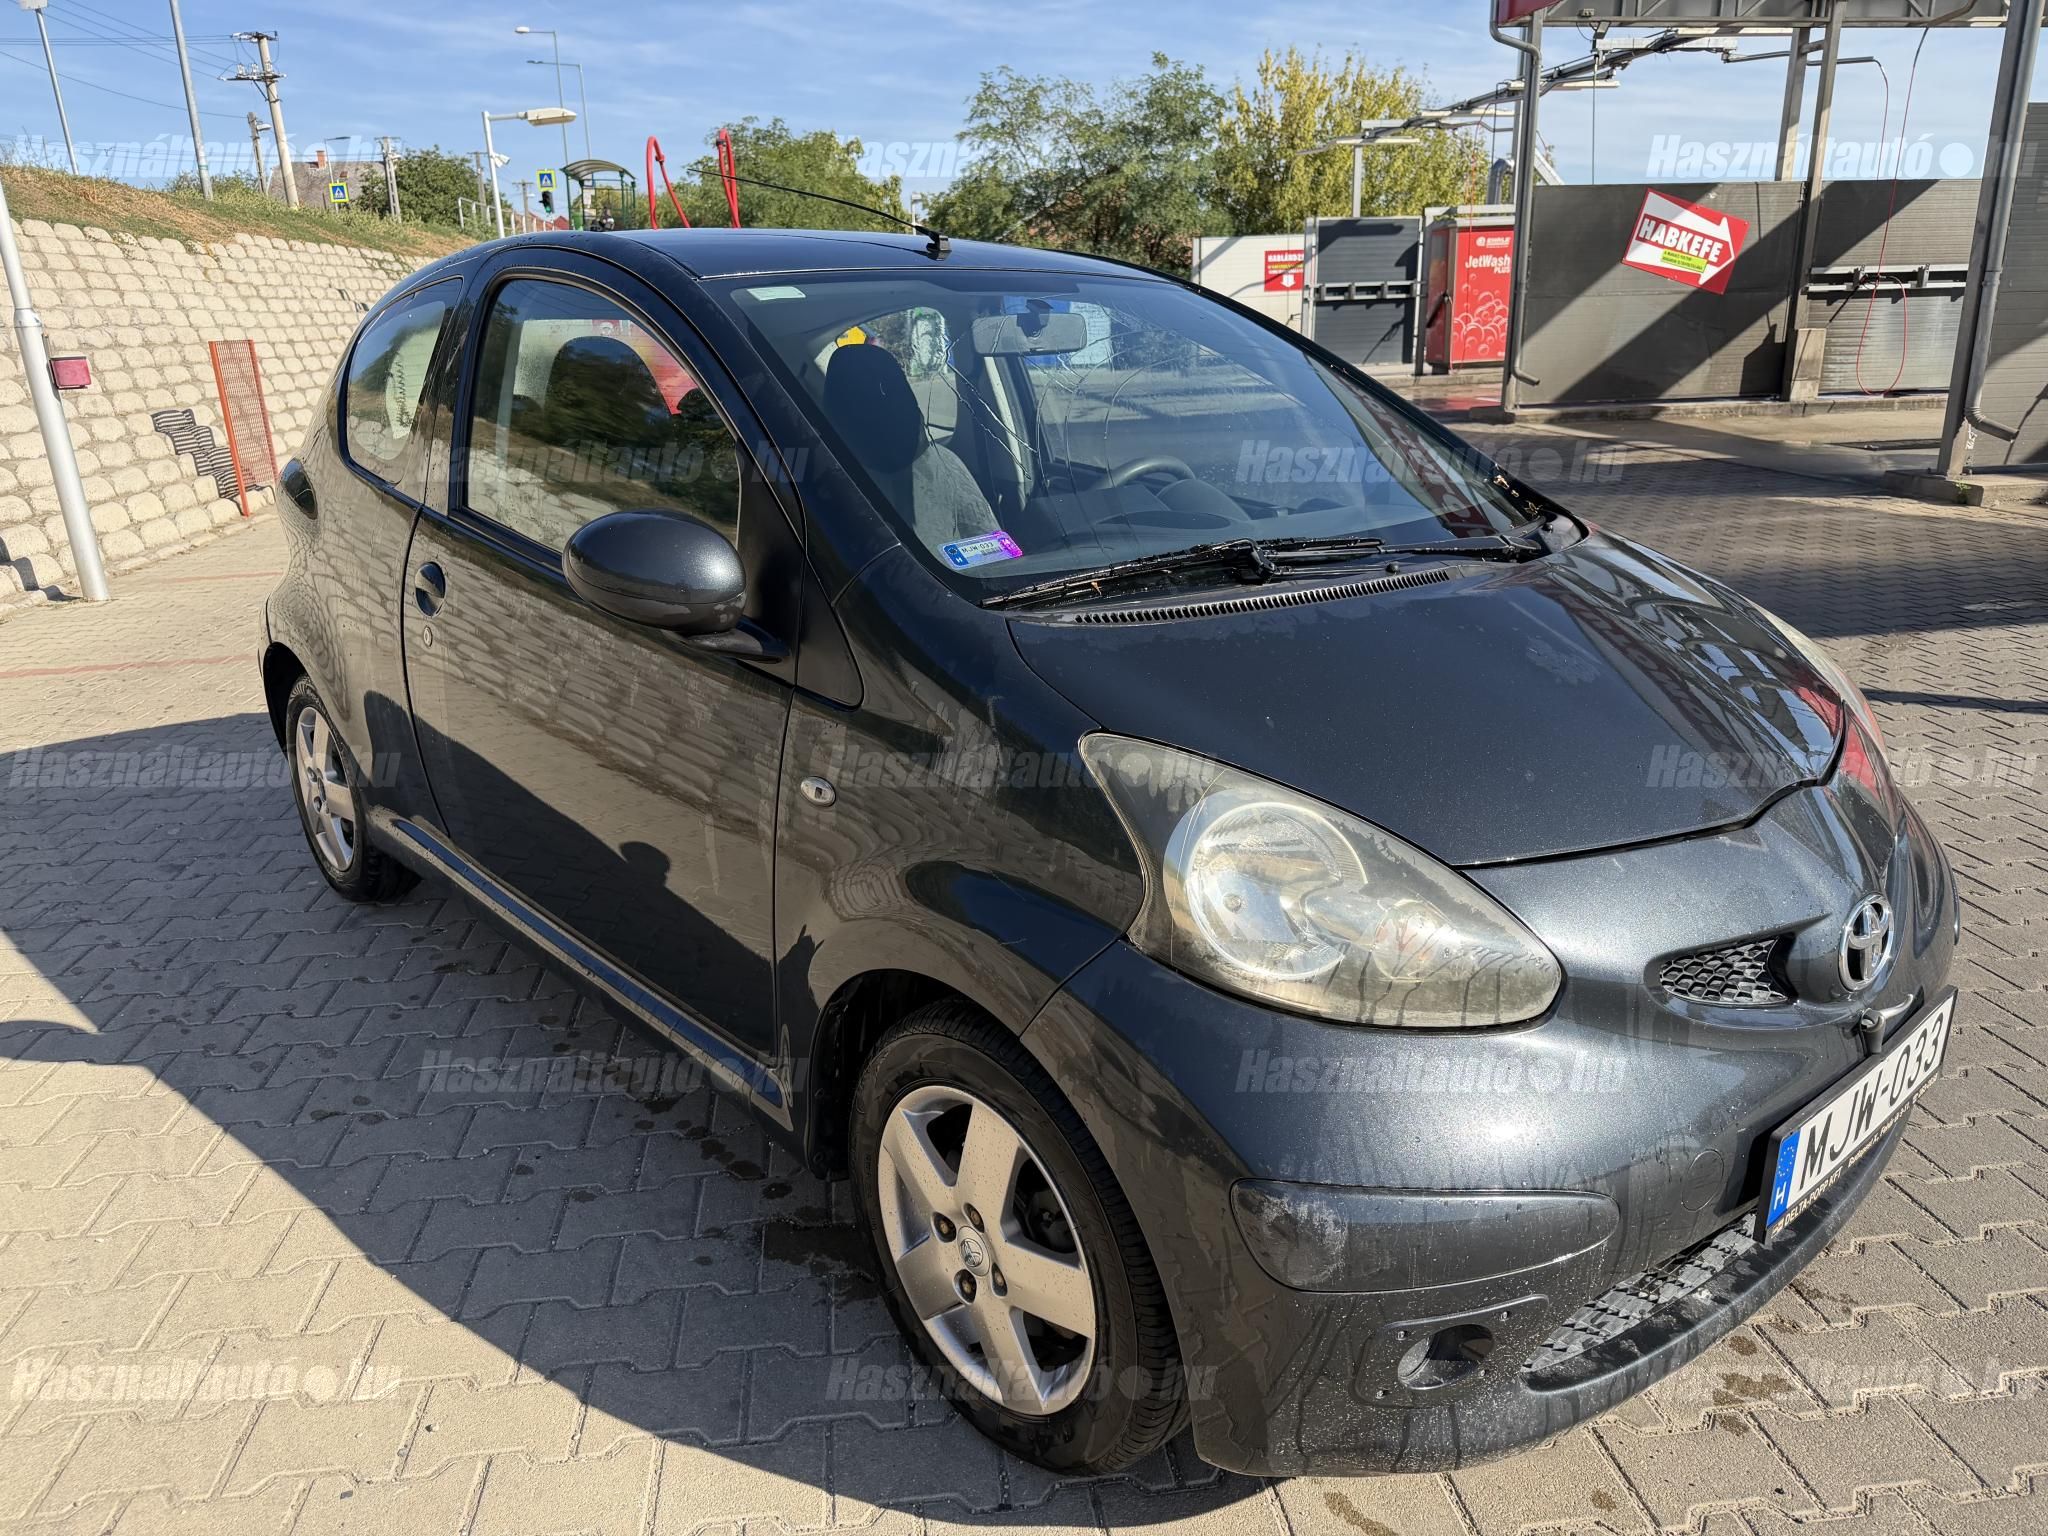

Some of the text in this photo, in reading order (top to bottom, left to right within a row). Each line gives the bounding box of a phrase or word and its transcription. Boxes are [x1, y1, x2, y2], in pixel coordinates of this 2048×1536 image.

[1465, 254, 1510, 268] JetWash
[1638, 217, 1723, 263] HABKEFE
[1799, 1012, 1944, 1191] MJW-033
[1773, 1181, 1787, 1211] H
[1784, 1180, 1829, 1226] DELTA-POPP
